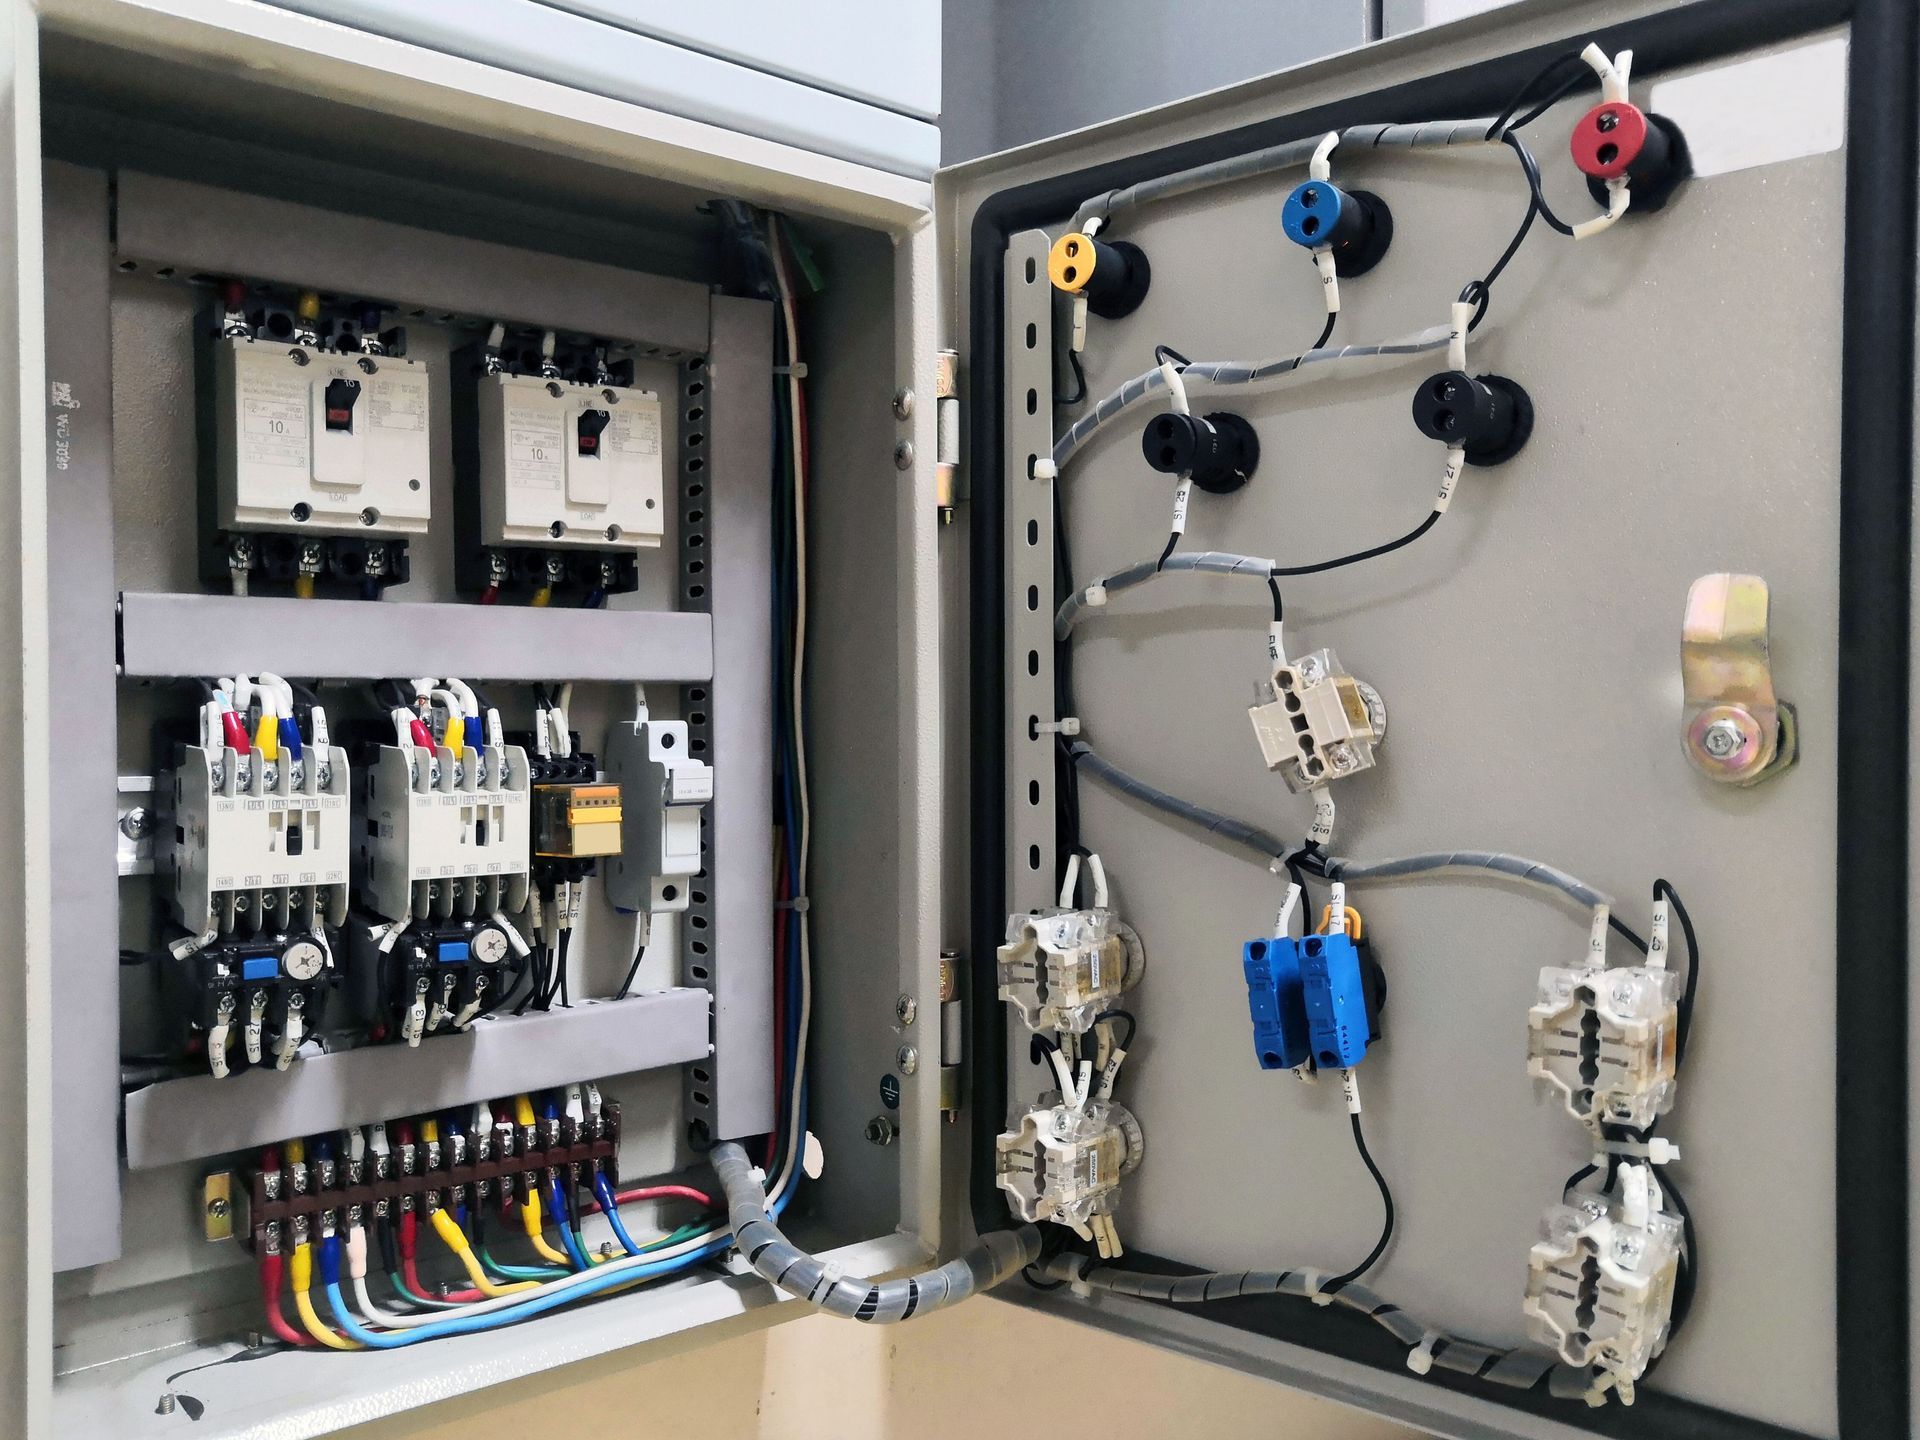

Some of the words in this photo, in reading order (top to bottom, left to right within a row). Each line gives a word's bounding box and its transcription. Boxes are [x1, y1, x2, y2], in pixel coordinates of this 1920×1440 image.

[1450, 331, 1459, 340] N
[344, 379, 355, 388] 10
[269, 419, 284, 434] 10
[532, 447, 543, 460] 10
